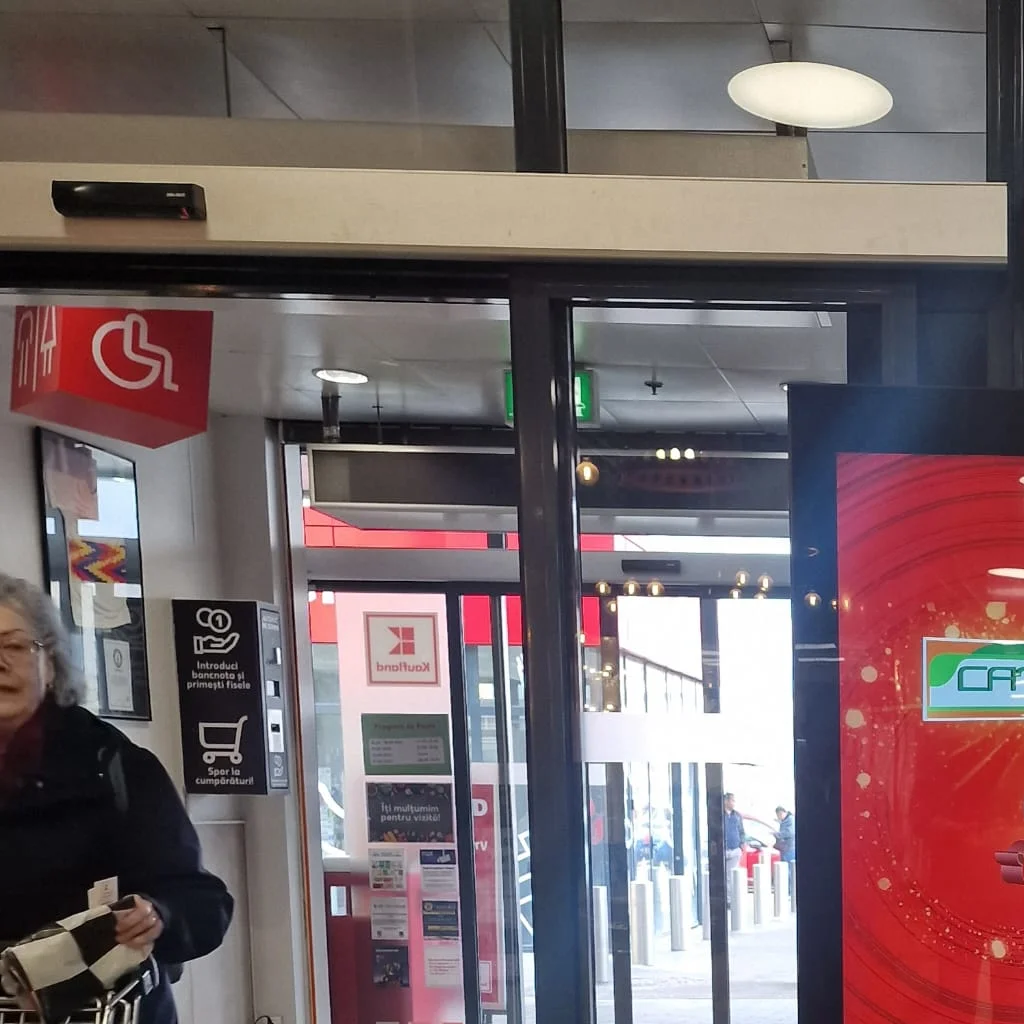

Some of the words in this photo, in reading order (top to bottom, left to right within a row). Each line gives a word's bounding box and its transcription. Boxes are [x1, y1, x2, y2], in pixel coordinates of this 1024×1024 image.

[197, 660, 238, 671] Introduci
[192, 671, 236, 680] bancnota
[226, 680, 251, 690] fisele
[207, 766, 230, 778] Spor
[231, 767, 241, 777] la
[380, 813, 411, 823] pentru
